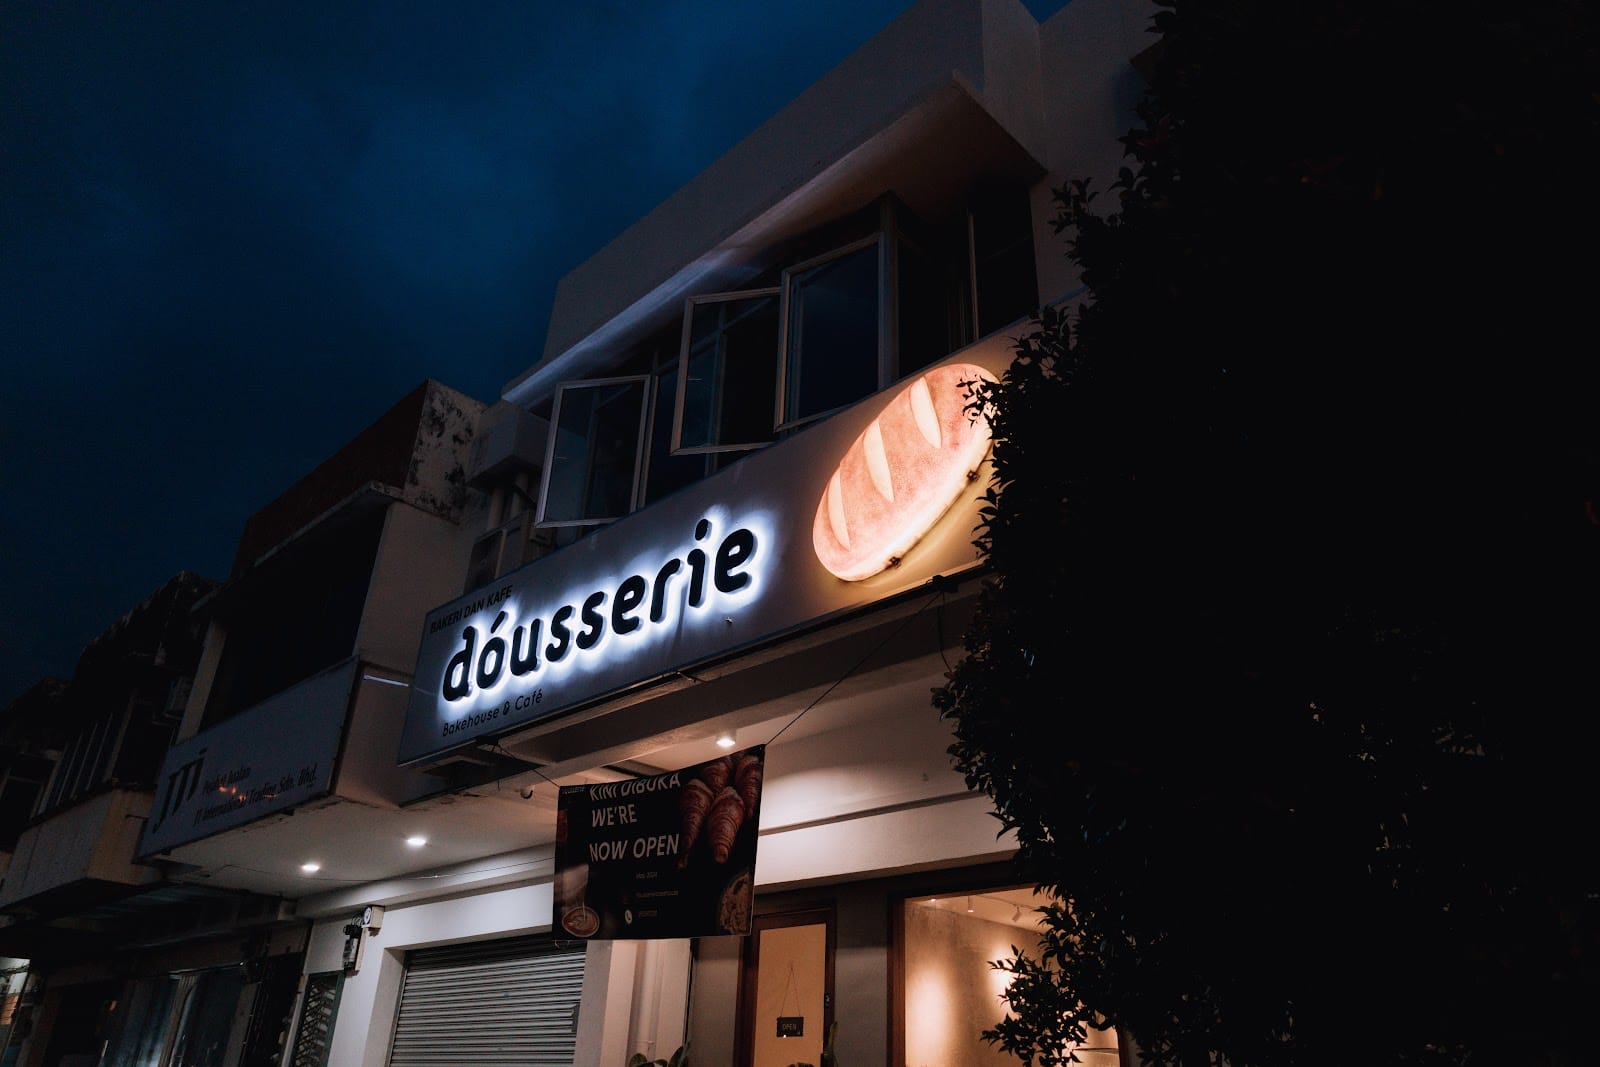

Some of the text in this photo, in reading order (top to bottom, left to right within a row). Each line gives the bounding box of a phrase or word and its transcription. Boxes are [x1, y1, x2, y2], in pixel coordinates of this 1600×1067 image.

[430, 585, 513, 634] BAKERI DAN KAFE
[442, 518, 754, 701] dóusserie
[443, 688, 543, 736] Bakehouse & Café
[591, 804, 638, 827] WE'RE
[589, 833, 680, 862] NOW OPEN
